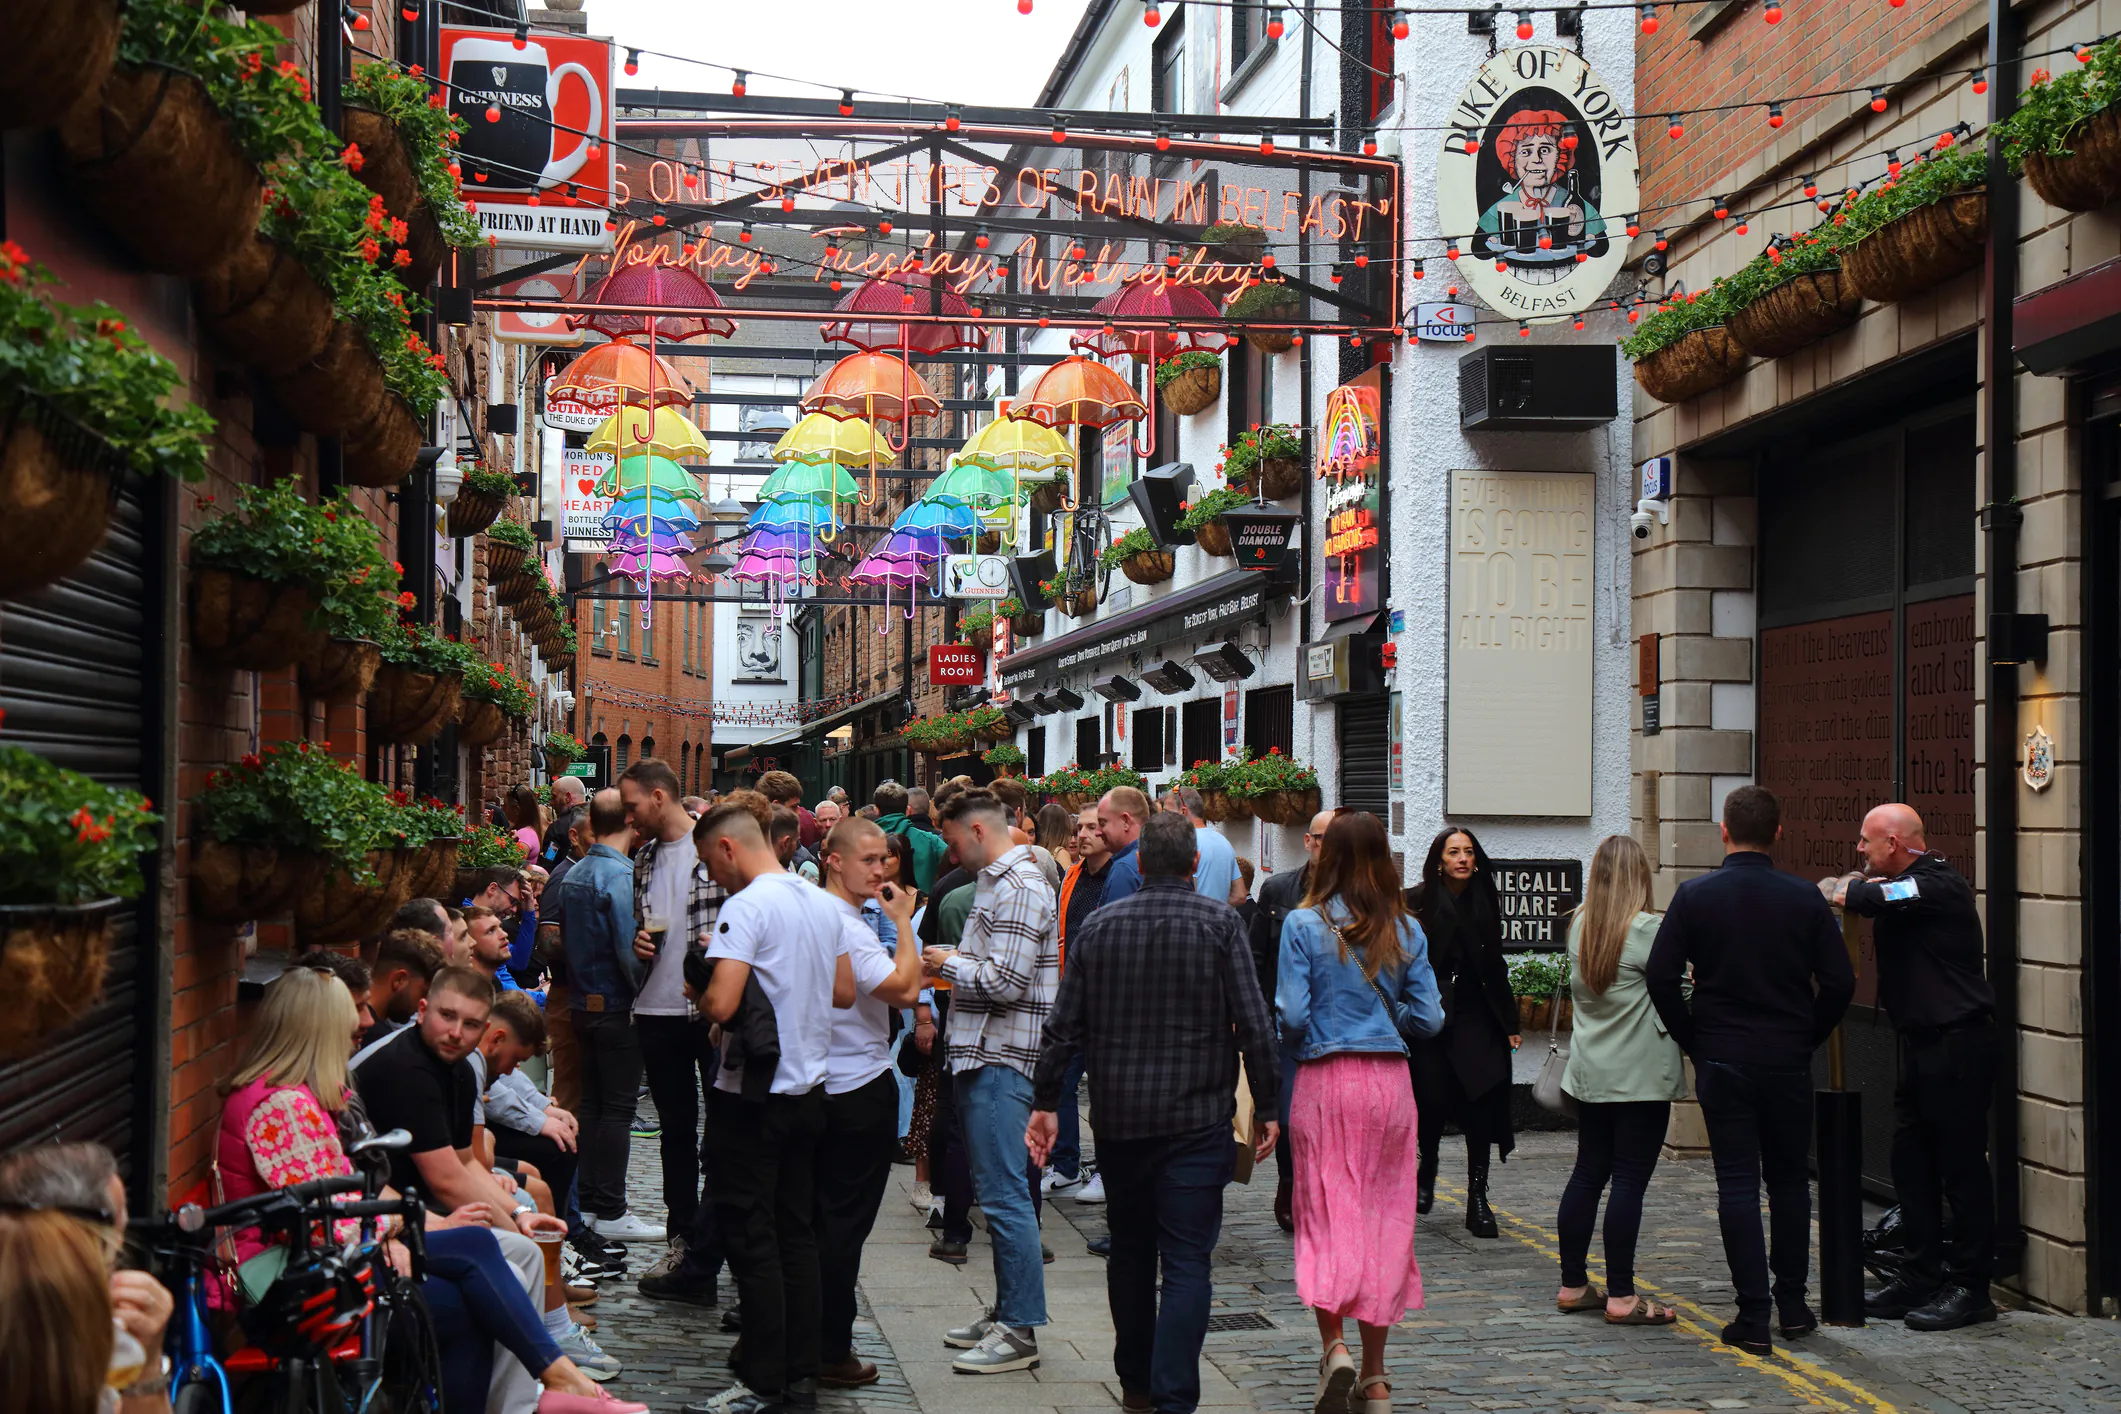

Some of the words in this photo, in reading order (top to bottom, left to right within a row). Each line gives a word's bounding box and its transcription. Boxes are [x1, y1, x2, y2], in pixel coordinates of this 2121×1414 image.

[458, 91, 542, 108] GUINNESS
[1443, 69, 1508, 157] DUKE
[1517, 49, 1558, 80] OF
[1573, 69, 1632, 161] YORK
[650, 160, 736, 203] ONLY
[756, 158, 870, 202] SEVEN
[890, 162, 1001, 206] TYPES
[1017, 167, 1061, 208] OF
[1076, 168, 1152, 218] RAIN
[478, 212, 533, 231] FRIEND
[537, 216, 556, 233] AT
[560, 216, 601, 237] HAND
[1500, 286, 1578, 312] BELFAST
[1426, 321, 1467, 338] focus
[549, 414, 563, 422] THE
[566, 416, 585, 424] DUKE
[571, 466, 603, 475] RED
[1458, 477, 1588, 507] EVERYTHING
[1643, 479, 1658, 496] focus
[564, 527, 611, 536] GUINNESS
[1238, 536, 1284, 545] DIAMOND
[1243, 525, 1281, 534] DOUBLE
[1458, 508, 1486, 549] IS
[1495, 509, 1588, 549] GOING
[1458, 551, 1516, 614] TO
[1531, 553, 1587, 614] BE
[1458, 615, 1502, 650] ALL
[1510, 616, 1586, 651] RIGHT
[1802, 632, 1823, 664] the
[938, 654, 976, 662] LADIES
[940, 667, 974, 676] ROOM
[1911, 651, 1946, 697] and
[1852, 669, 1891, 704] golden
[1814, 712, 1837, 742] and
[1841, 712, 1862, 741] the
[1866, 710, 1890, 740] dim
[1911, 706, 1939, 741] and
[1944, 704, 1970, 740] the
[1809, 752, 1830, 781] and
[1834, 751, 1862, 787] light
[1866, 752, 1890, 781] and
[1911, 749, 1946, 796] the
[1814, 789, 1862, 829] spread
[1803, 829, 1844, 876] being
